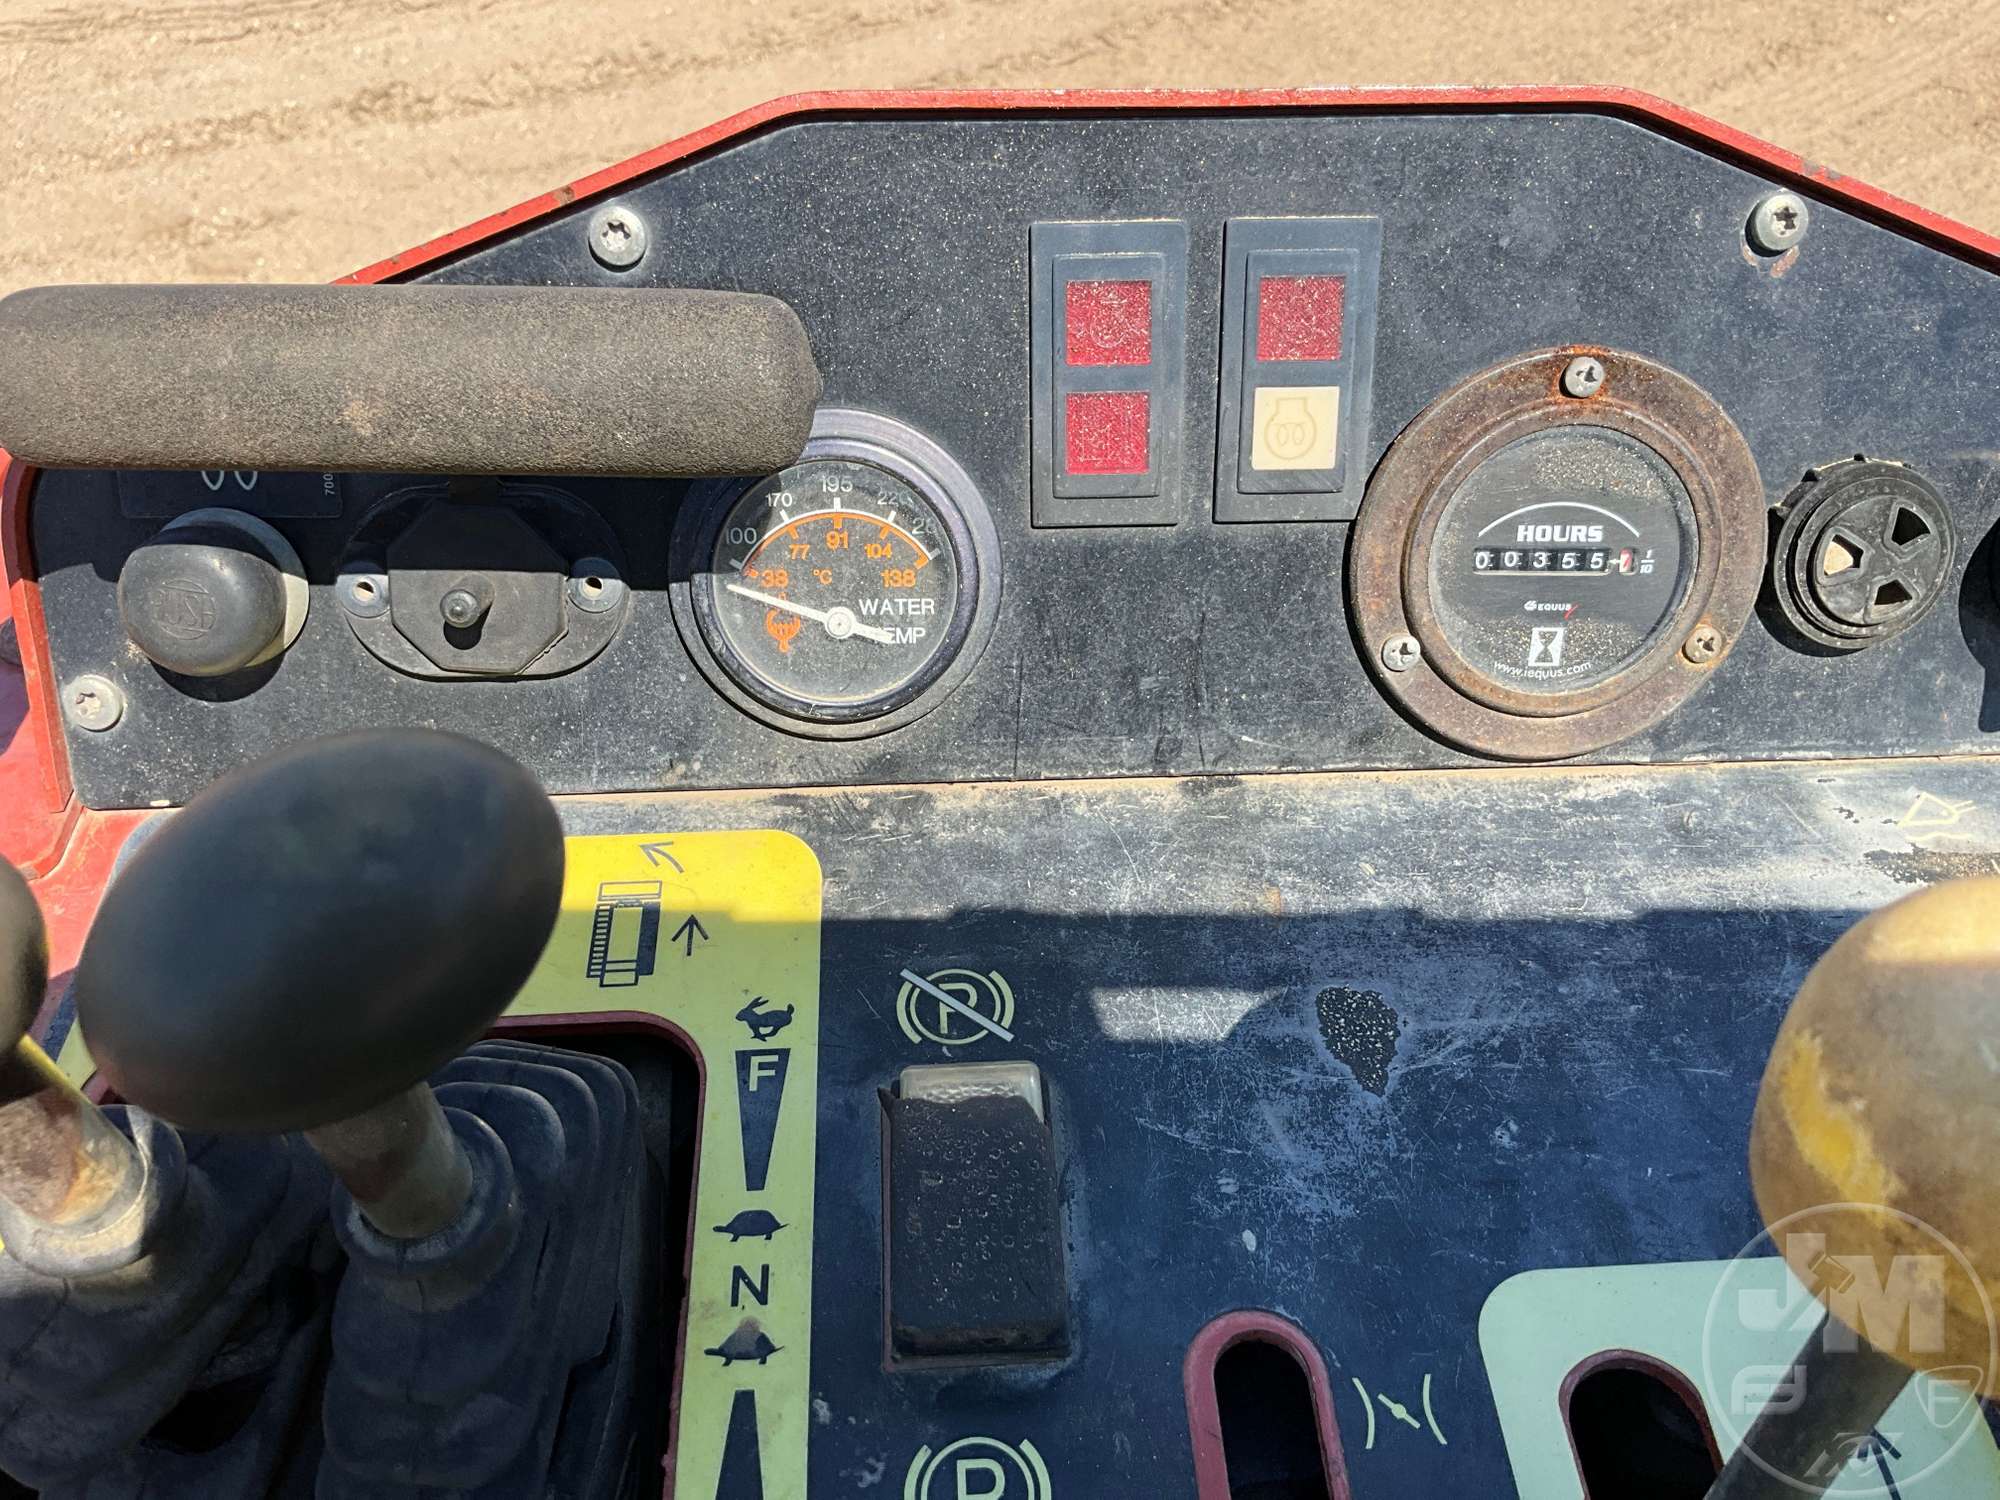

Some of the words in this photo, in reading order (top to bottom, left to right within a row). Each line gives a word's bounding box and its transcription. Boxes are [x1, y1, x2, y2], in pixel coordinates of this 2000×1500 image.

[821, 475, 853, 492] 195
[766, 492, 793, 507] 170
[725, 527, 757, 544] 100
[826, 531, 849, 550] 91
[1516, 525, 1604, 542] HOURS
[789, 544, 810, 560] 77
[864, 543, 892, 559] 104
[880, 568, 916, 588] 138
[858, 598, 935, 616] WATER
[876, 627, 926, 644] EMP
[1493, 660, 1592, 679] www.iequus.com
[748, 1053, 780, 1092] F
[730, 1263, 770, 1308] N
